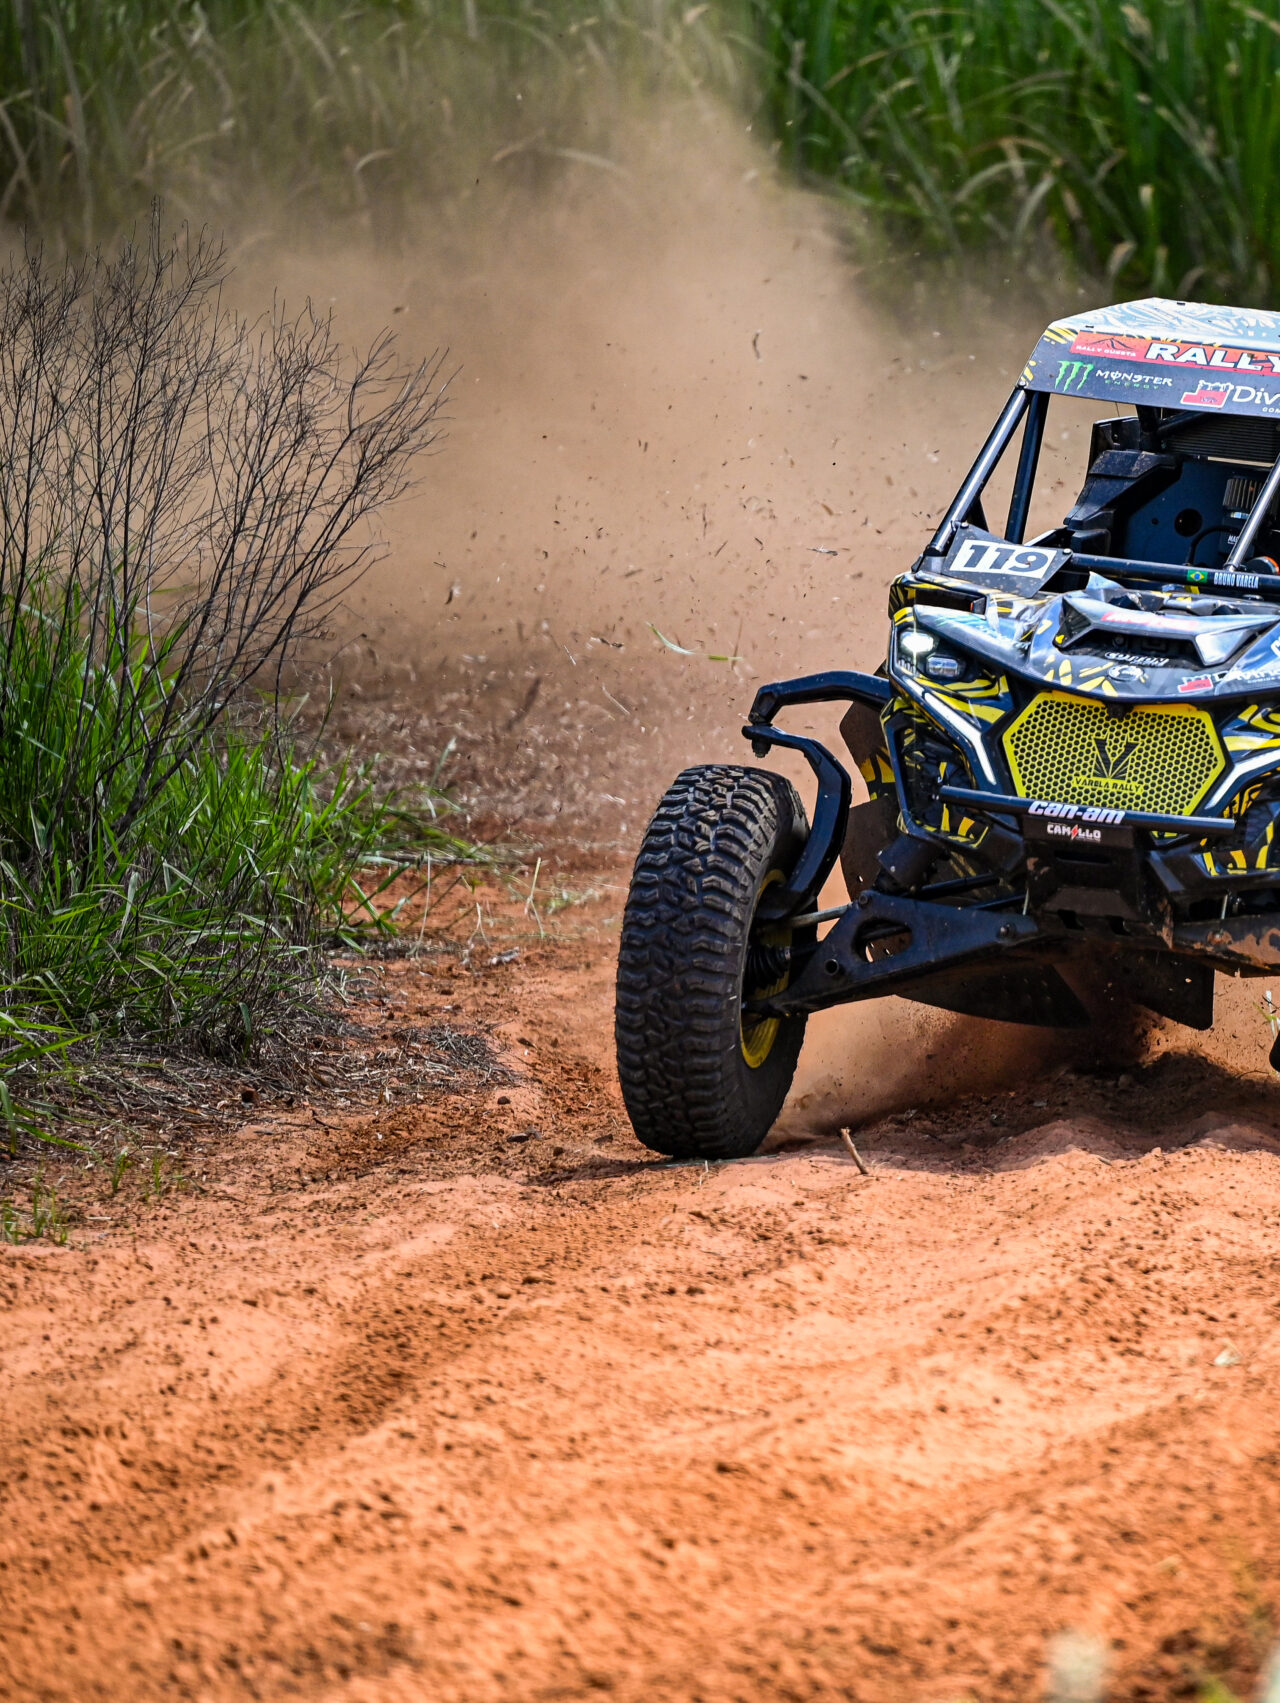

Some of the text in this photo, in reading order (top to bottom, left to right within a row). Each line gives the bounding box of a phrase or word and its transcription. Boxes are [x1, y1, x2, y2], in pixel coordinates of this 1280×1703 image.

[1096, 369, 1172, 386] MONSTER
[1105, 380, 1159, 390] ENERGY
[963, 544, 1049, 573] 119
[1213, 571, 1259, 589] BRUNO VARELA
[1075, 777, 1141, 793] VARELA RALLY
[1028, 800, 1126, 824] can-am
